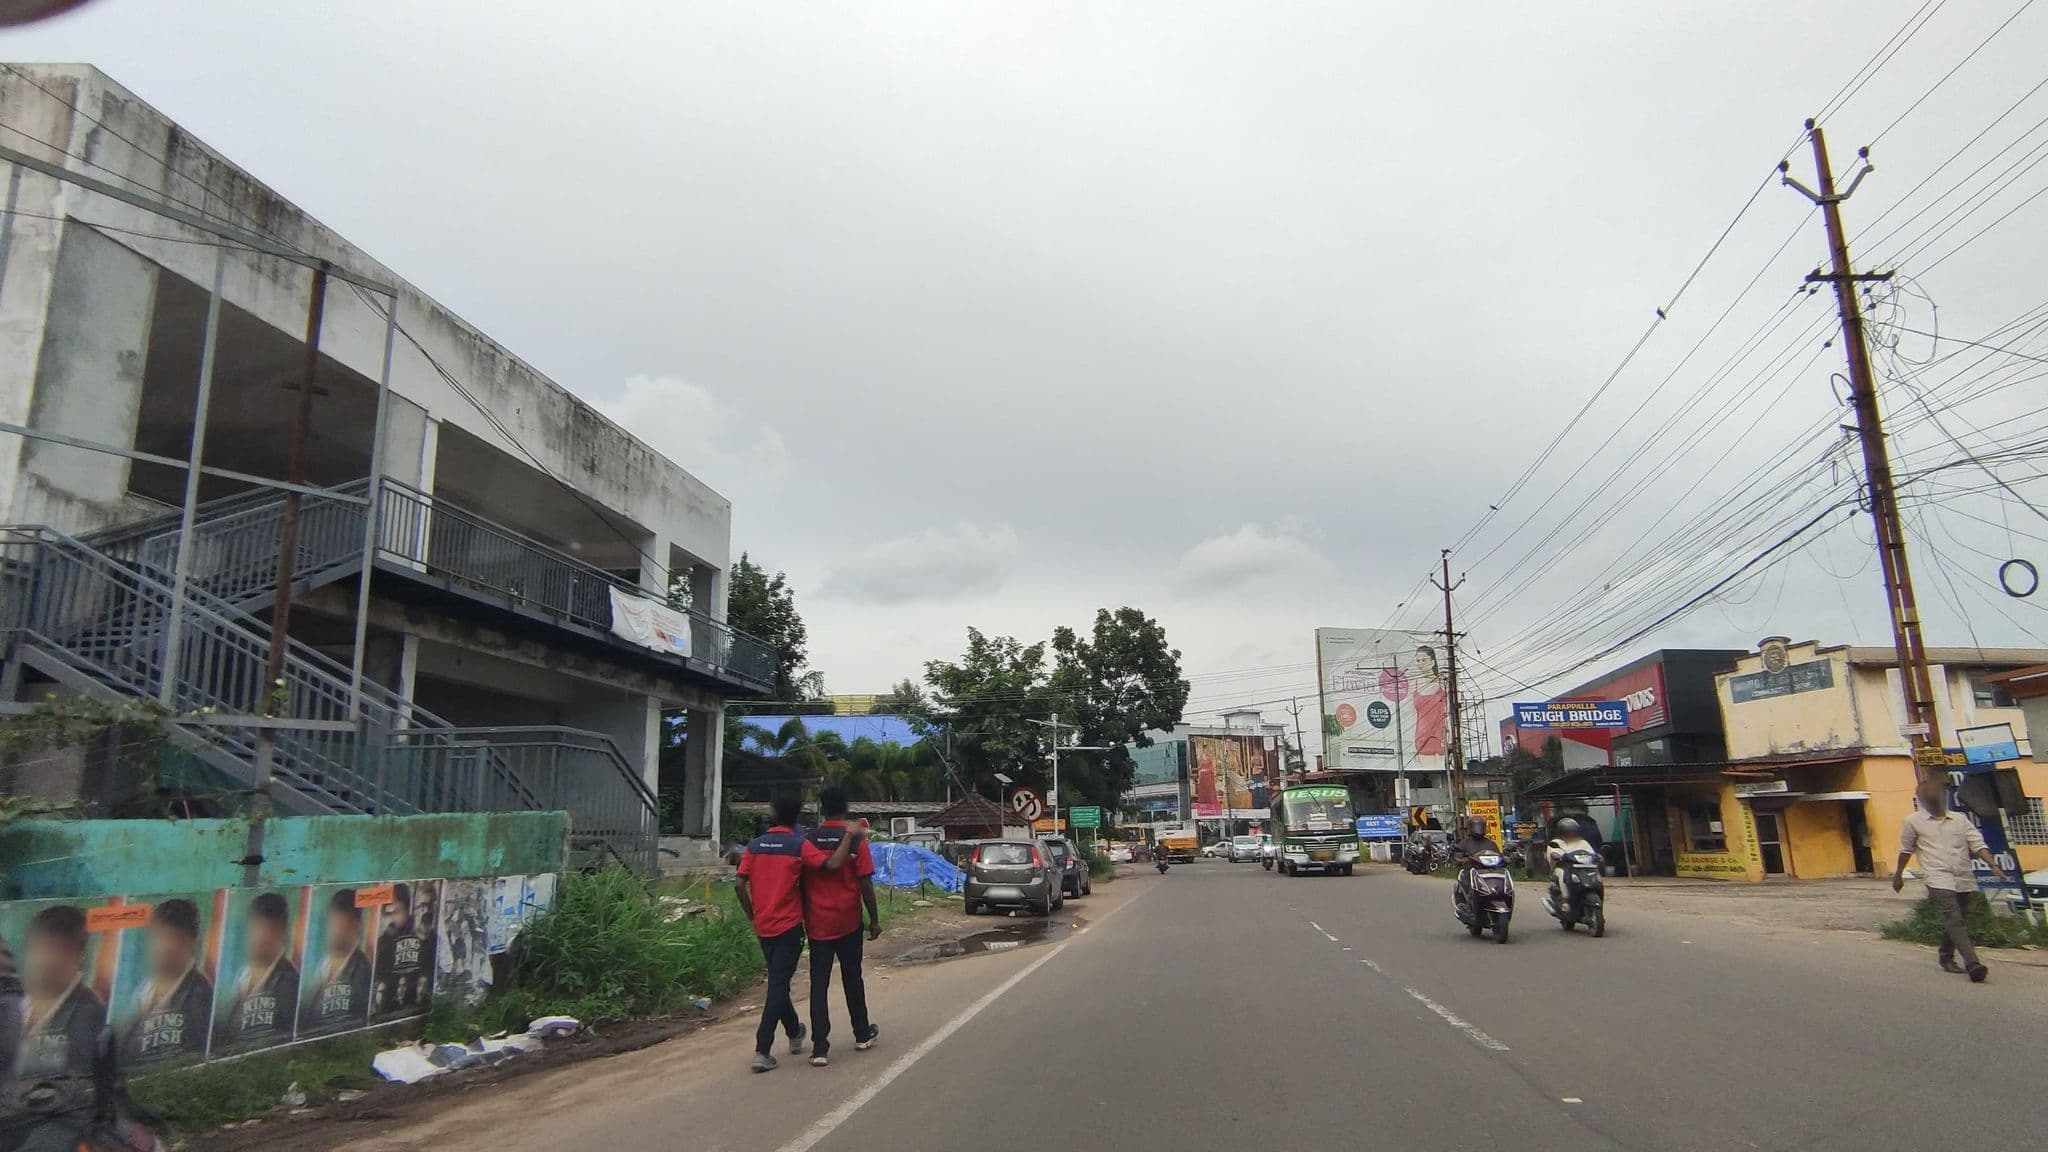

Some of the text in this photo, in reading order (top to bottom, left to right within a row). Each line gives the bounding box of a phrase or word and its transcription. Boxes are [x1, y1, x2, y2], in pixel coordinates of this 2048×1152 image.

[1520, 710, 1622, 722] WEIGH BRIDGE
[1286, 789, 1347, 799] JESUS
[397, 937, 420, 952] KING
[395, 951, 418, 966] FISH
[324, 984, 350, 999] KING
[243, 996, 276, 1014] KING
[323, 999, 350, 1015] FISH
[143, 1012, 183, 1033] KING
[241, 1012, 274, 1030] FISH
[142, 1031, 183, 1051] FISH
